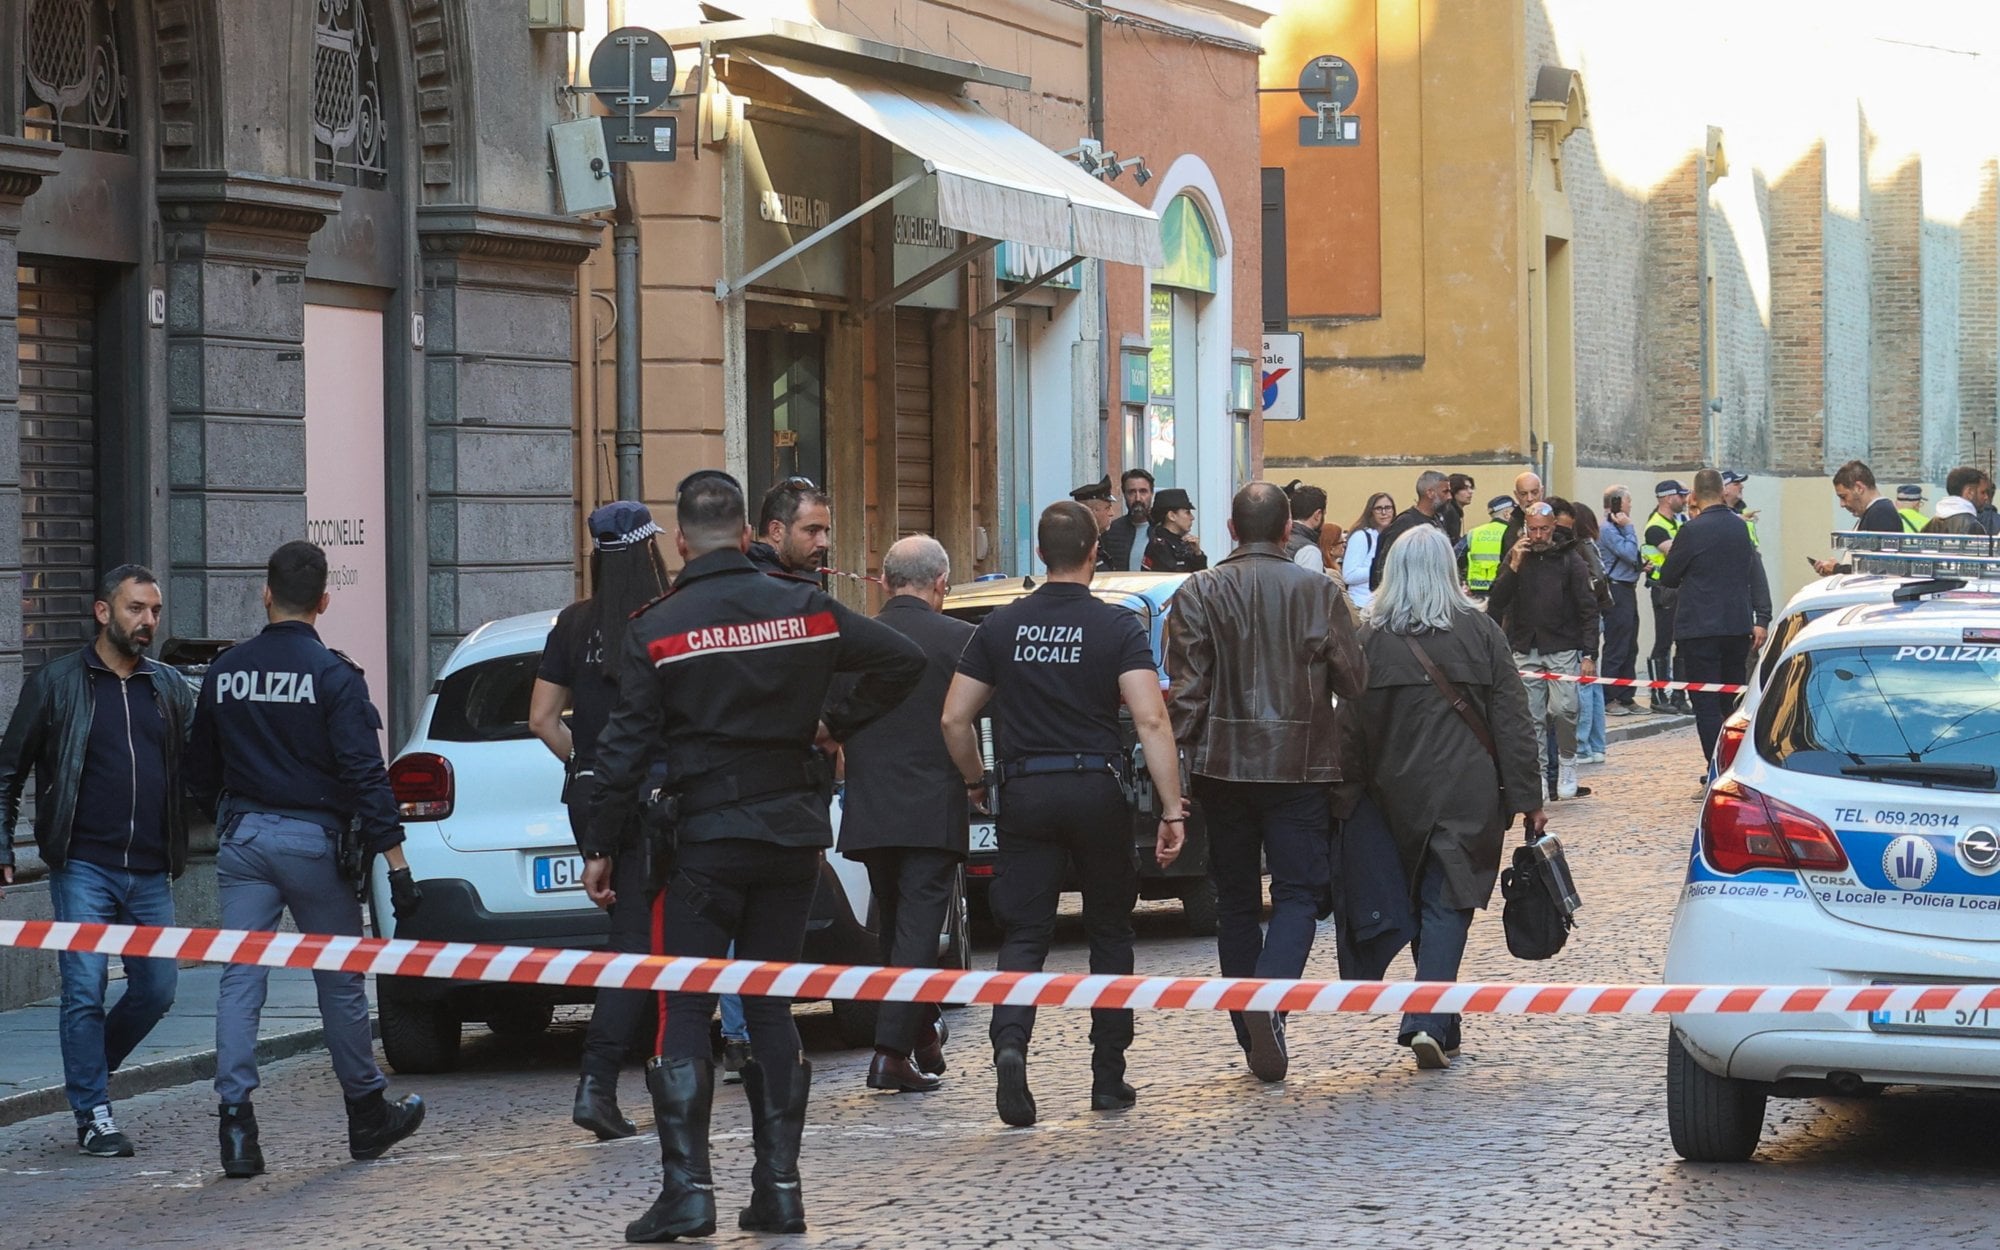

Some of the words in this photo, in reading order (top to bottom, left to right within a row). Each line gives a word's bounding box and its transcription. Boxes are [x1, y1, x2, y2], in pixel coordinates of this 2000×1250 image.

[307, 519, 364, 547] COCCINELLE
[687, 616, 807, 650] CARABINIERI
[1015, 625, 1083, 643] POLIZIA
[1013, 645, 1082, 663] LOCALE
[1895, 645, 2000, 662] POLIZIA
[217, 671, 317, 704] POLIZIA
[1835, 808, 1869, 823] TEL.
[1875, 810, 1960, 827] 059.20314
[1810, 875, 1857, 887] CORSA
[1719, 883, 1768, 897] Locale
[1836, 889, 1886, 904] Locale
[1902, 892, 1954, 908] Policía
